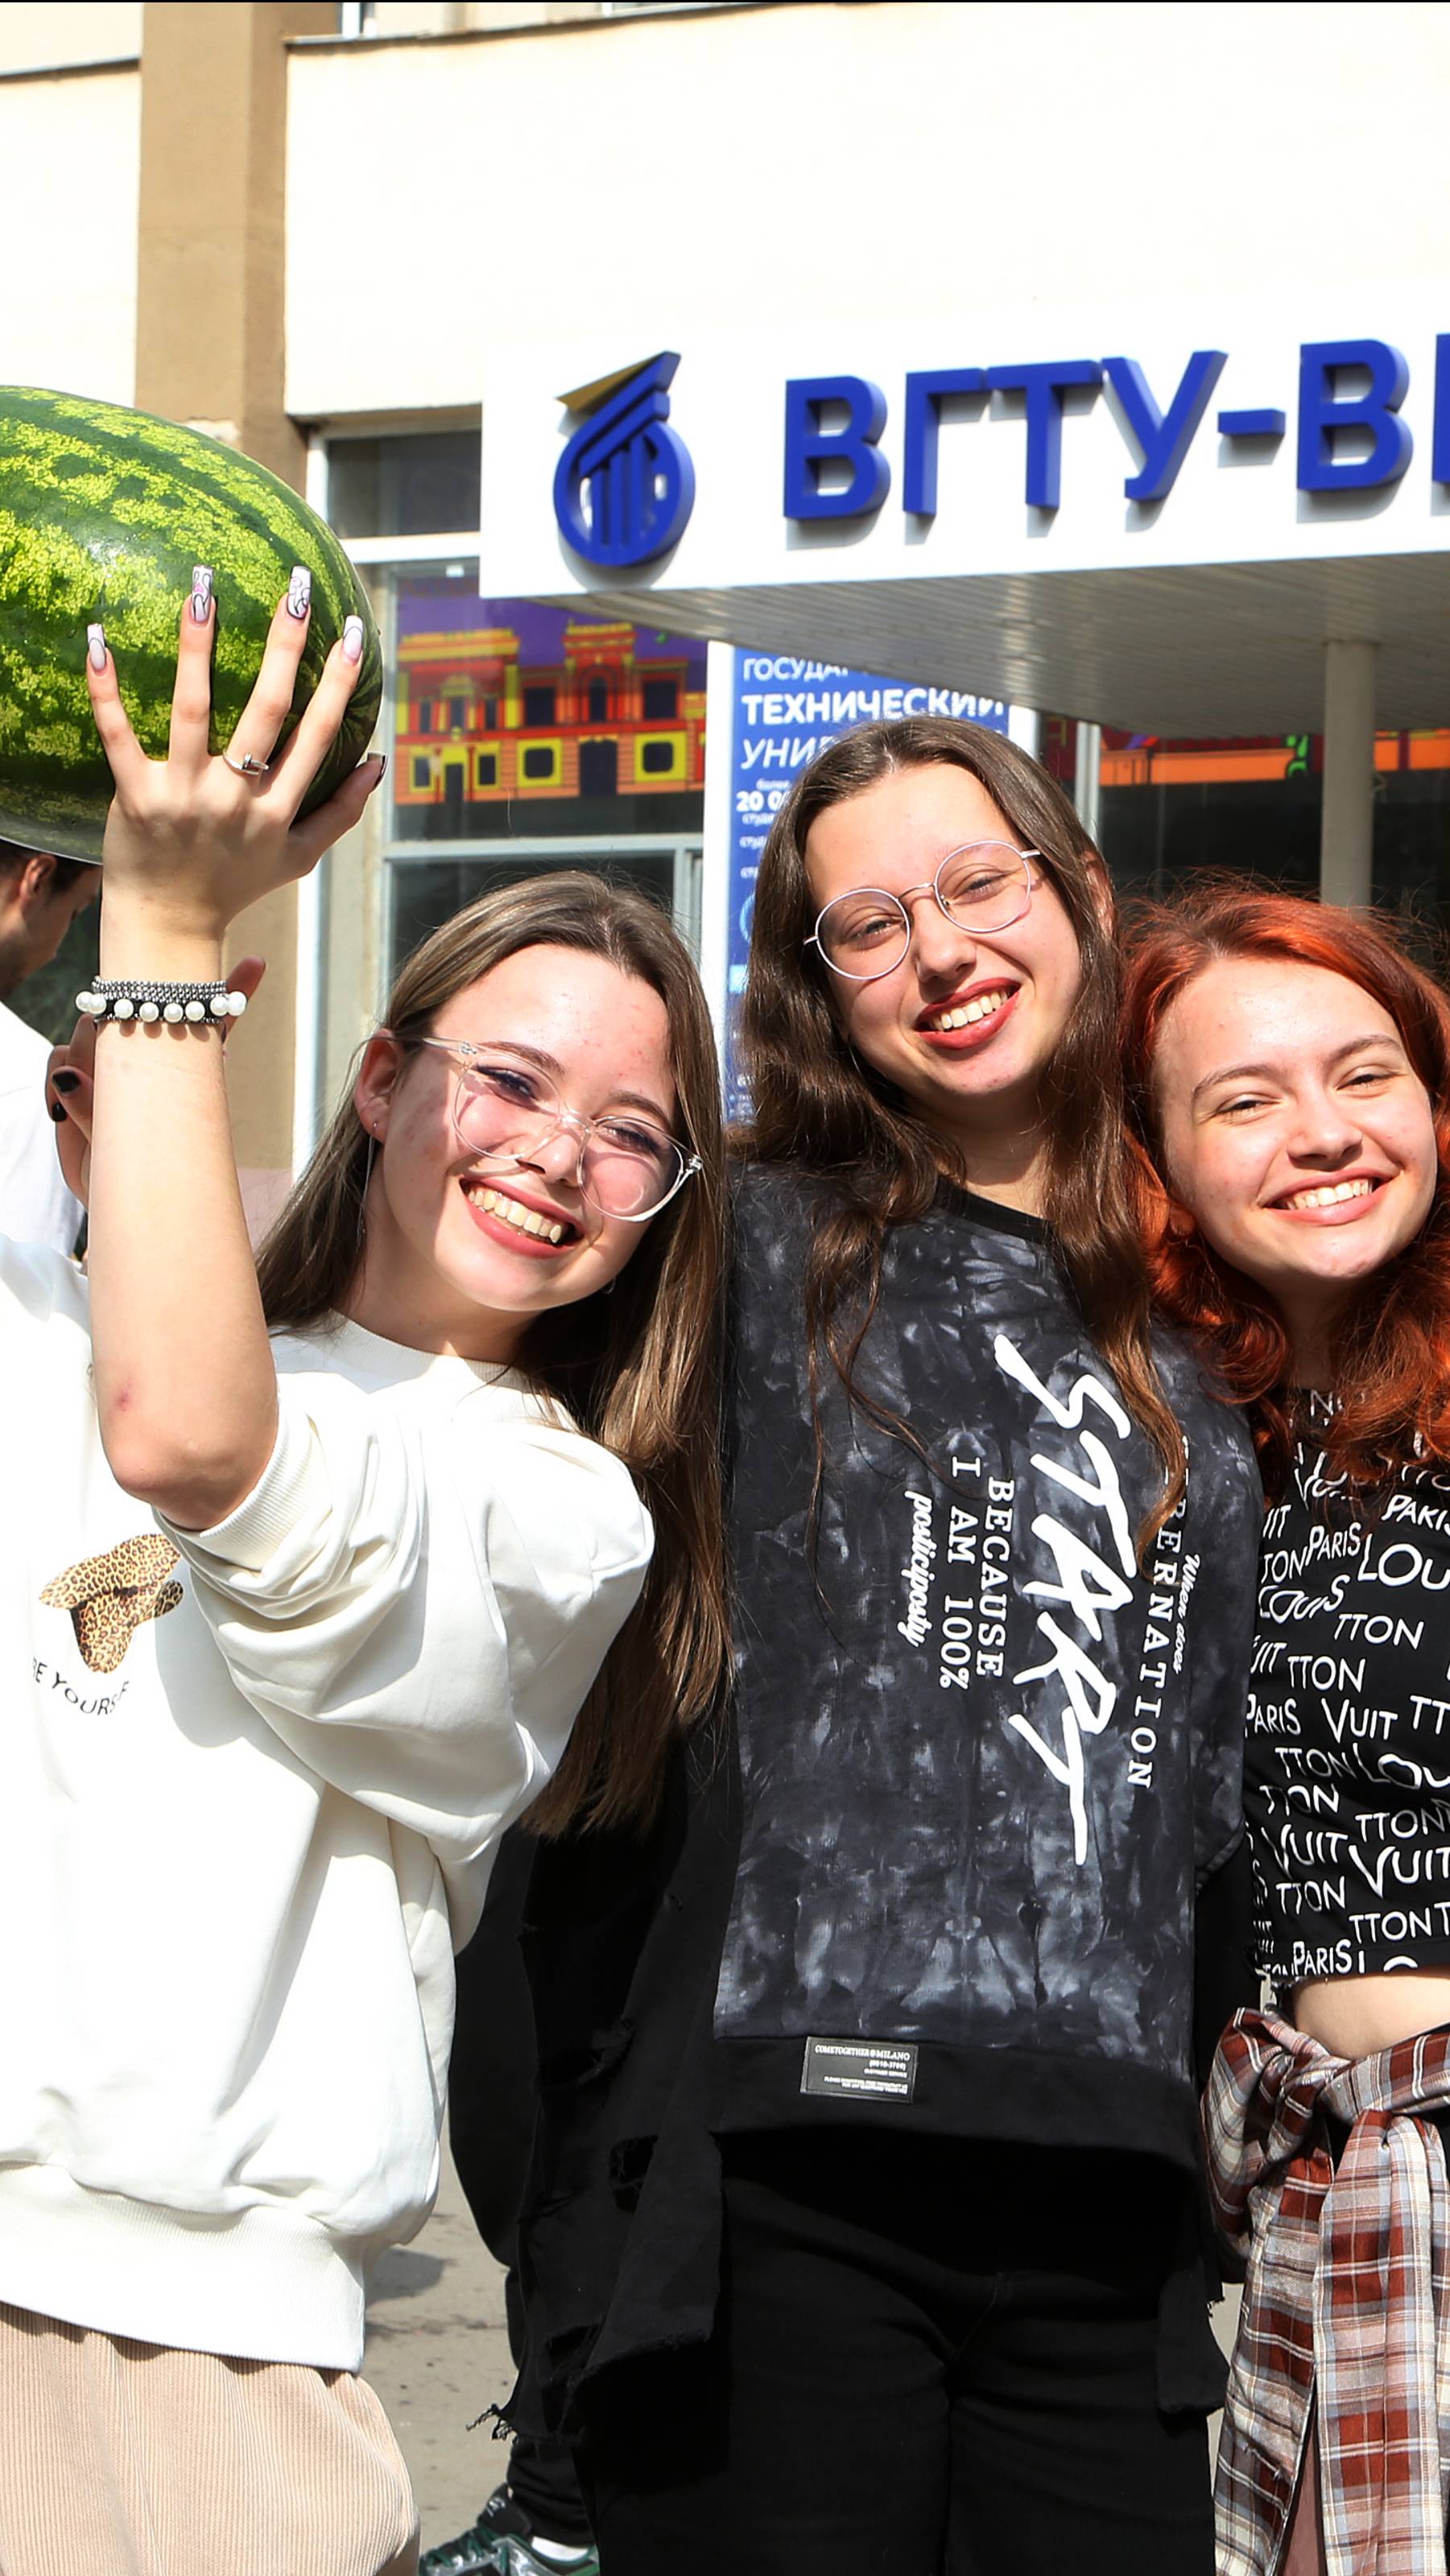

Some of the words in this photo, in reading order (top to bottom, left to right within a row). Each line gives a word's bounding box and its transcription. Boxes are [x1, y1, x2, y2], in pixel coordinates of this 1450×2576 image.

[783, 334, 1450, 520] ВГТУ-В
[736, 791, 765, 812] 20
[951, 1455, 981, 1479] I
[946, 1505, 979, 1565] AM
[1305, 1522, 1361, 1567] PARIS
[976, 1476, 1015, 1678] BECAUSE
[994, 1333, 1138, 1866] START
[1177, 1554, 1200, 1620] When
[939, 1595, 974, 1690] 100%
[1173, 1622, 1186, 1675] does
[1333, 1612, 1425, 1650] TTON
[1287, 1654, 1368, 1693] TTON
[1245, 1692, 1302, 1739] PARIS
[1321, 1698, 1398, 1743] VUIT
[1274, 1746, 1358, 1780] TTON
[1260, 1823, 1349, 1880] VUIT
[1348, 1845, 1450, 1899] VUIT
[1275, 1875, 1346, 1916] TTON
[1348, 1906, 1431, 1944] TTON
[1291, 1938, 1353, 1976] PARIS
